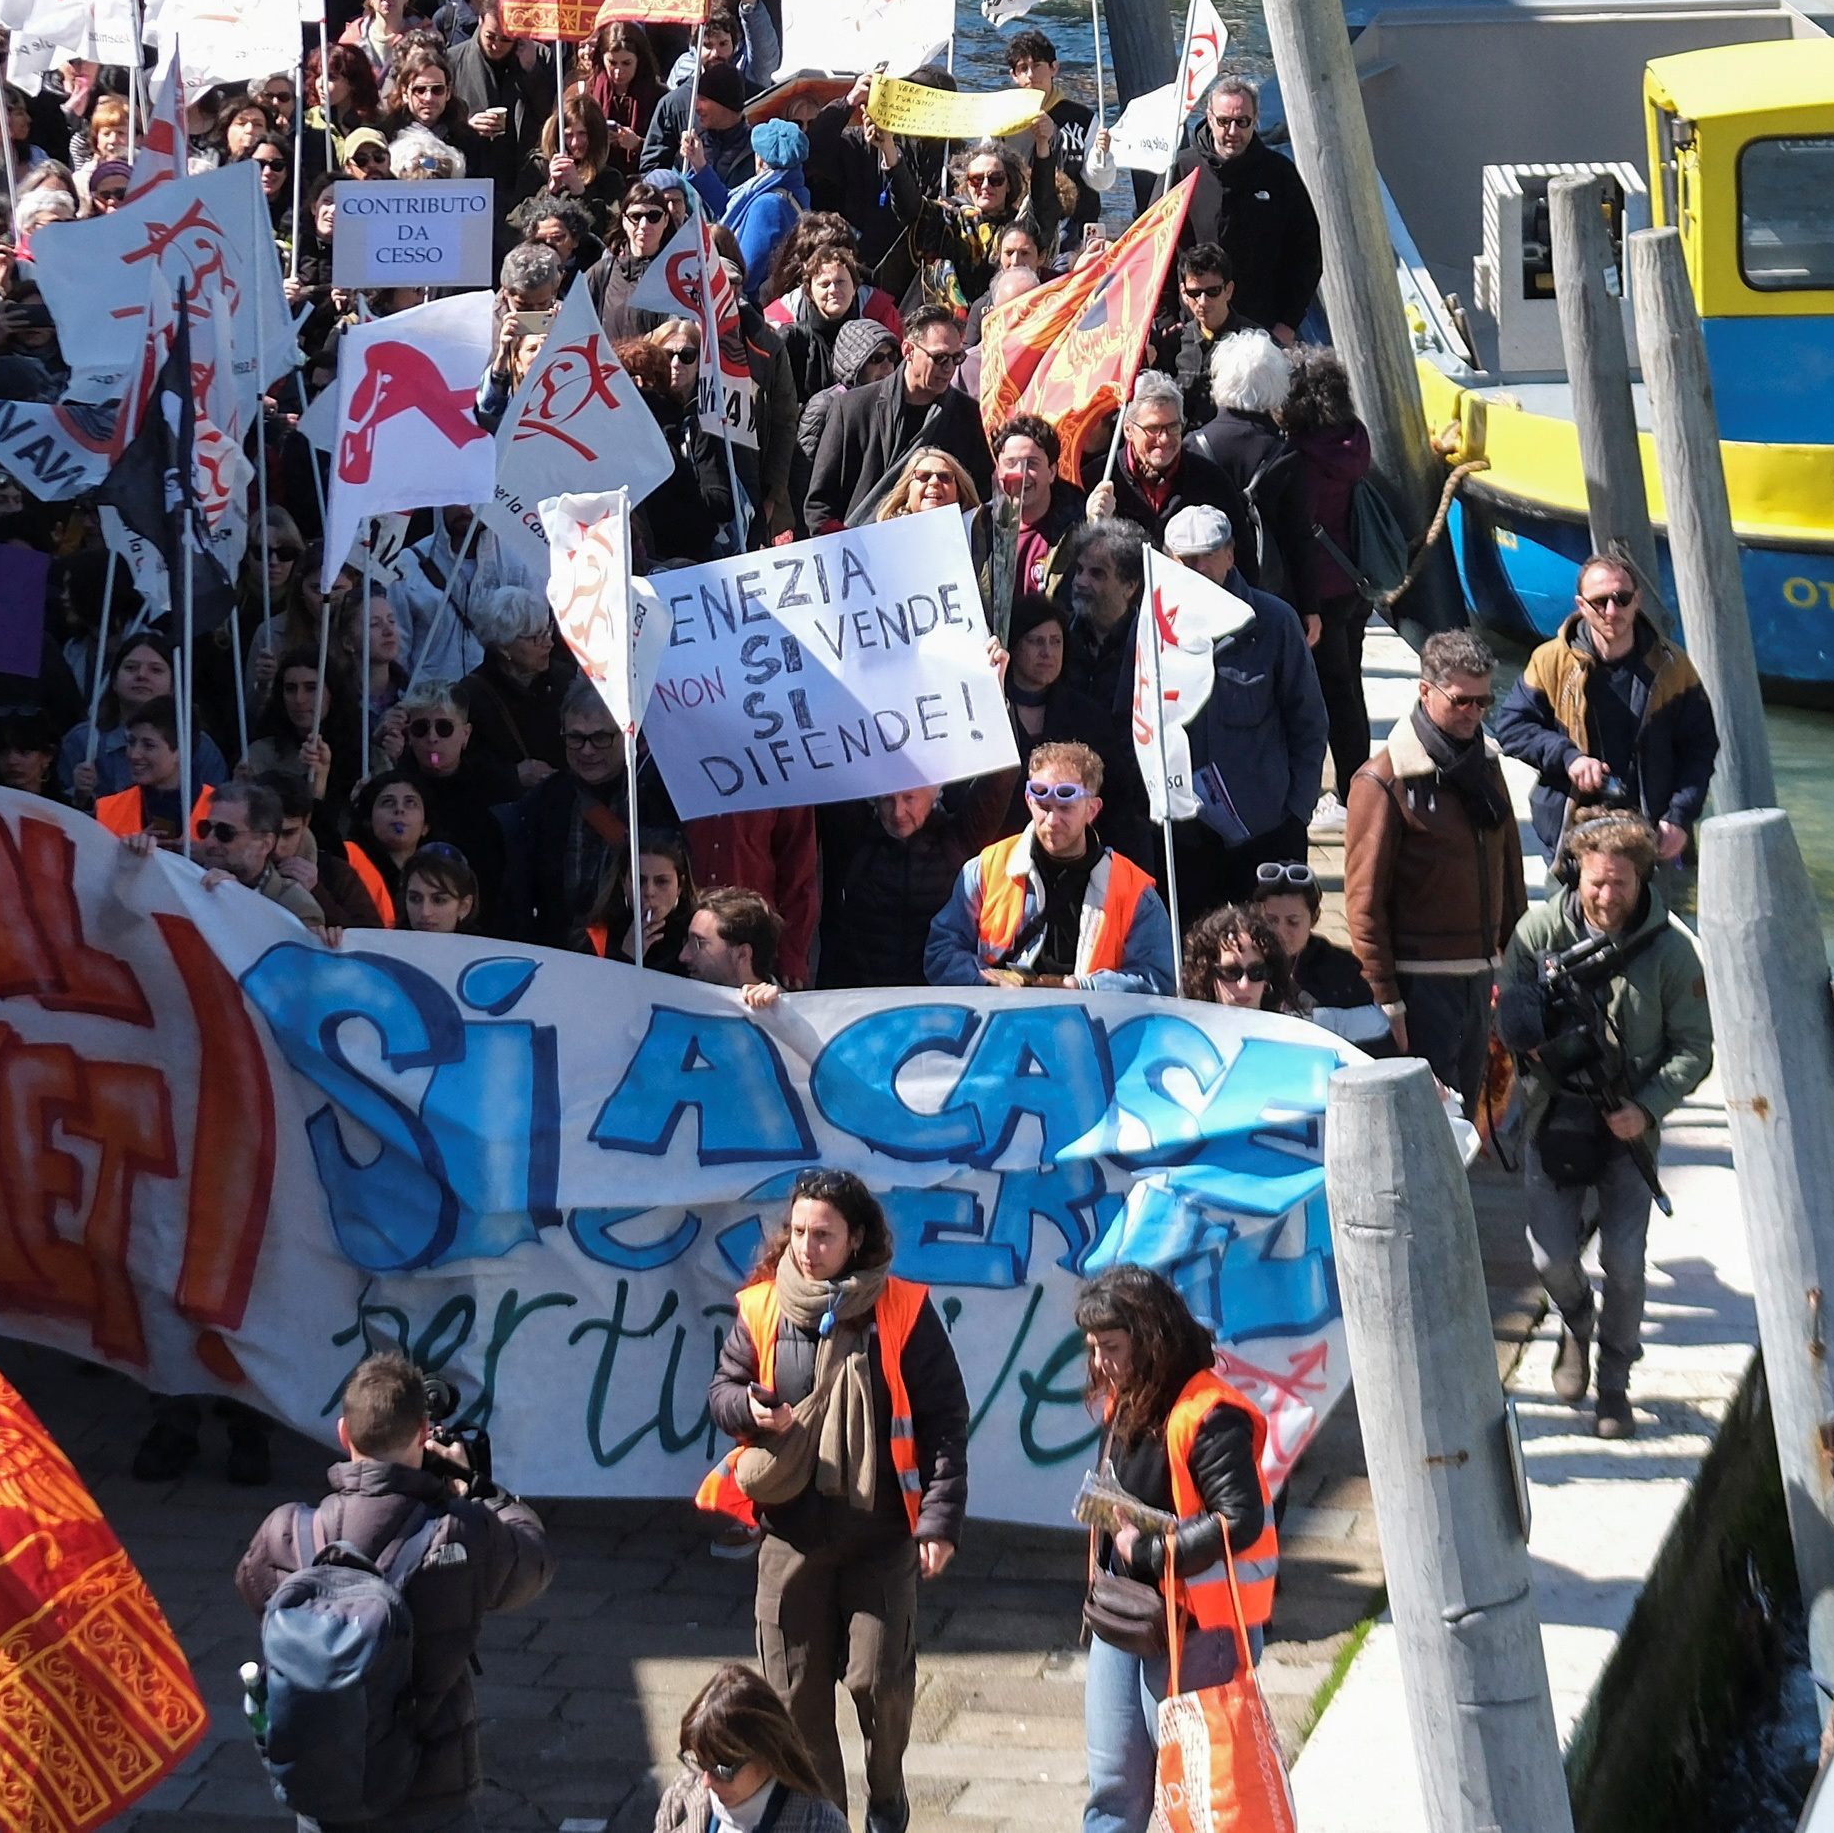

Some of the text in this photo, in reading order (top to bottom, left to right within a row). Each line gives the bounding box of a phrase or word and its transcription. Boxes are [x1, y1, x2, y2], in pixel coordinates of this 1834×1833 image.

[878, 76, 890, 88] LE
[898, 83, 922, 95] VERE
[895, 94, 935, 107] TURISMO
[342, 195, 487, 215] CONTRIBUTO
[397, 225, 430, 241] DA
[375, 246, 444, 264] CESSO
[505, 495, 523, 515] la
[669, 545, 878, 648] ENEZIA
[740, 582, 973, 686] SI VENDE,
[655, 667, 726, 714] NON
[741, 687, 815, 740] SI
[587, 1003, 820, 1164] A
